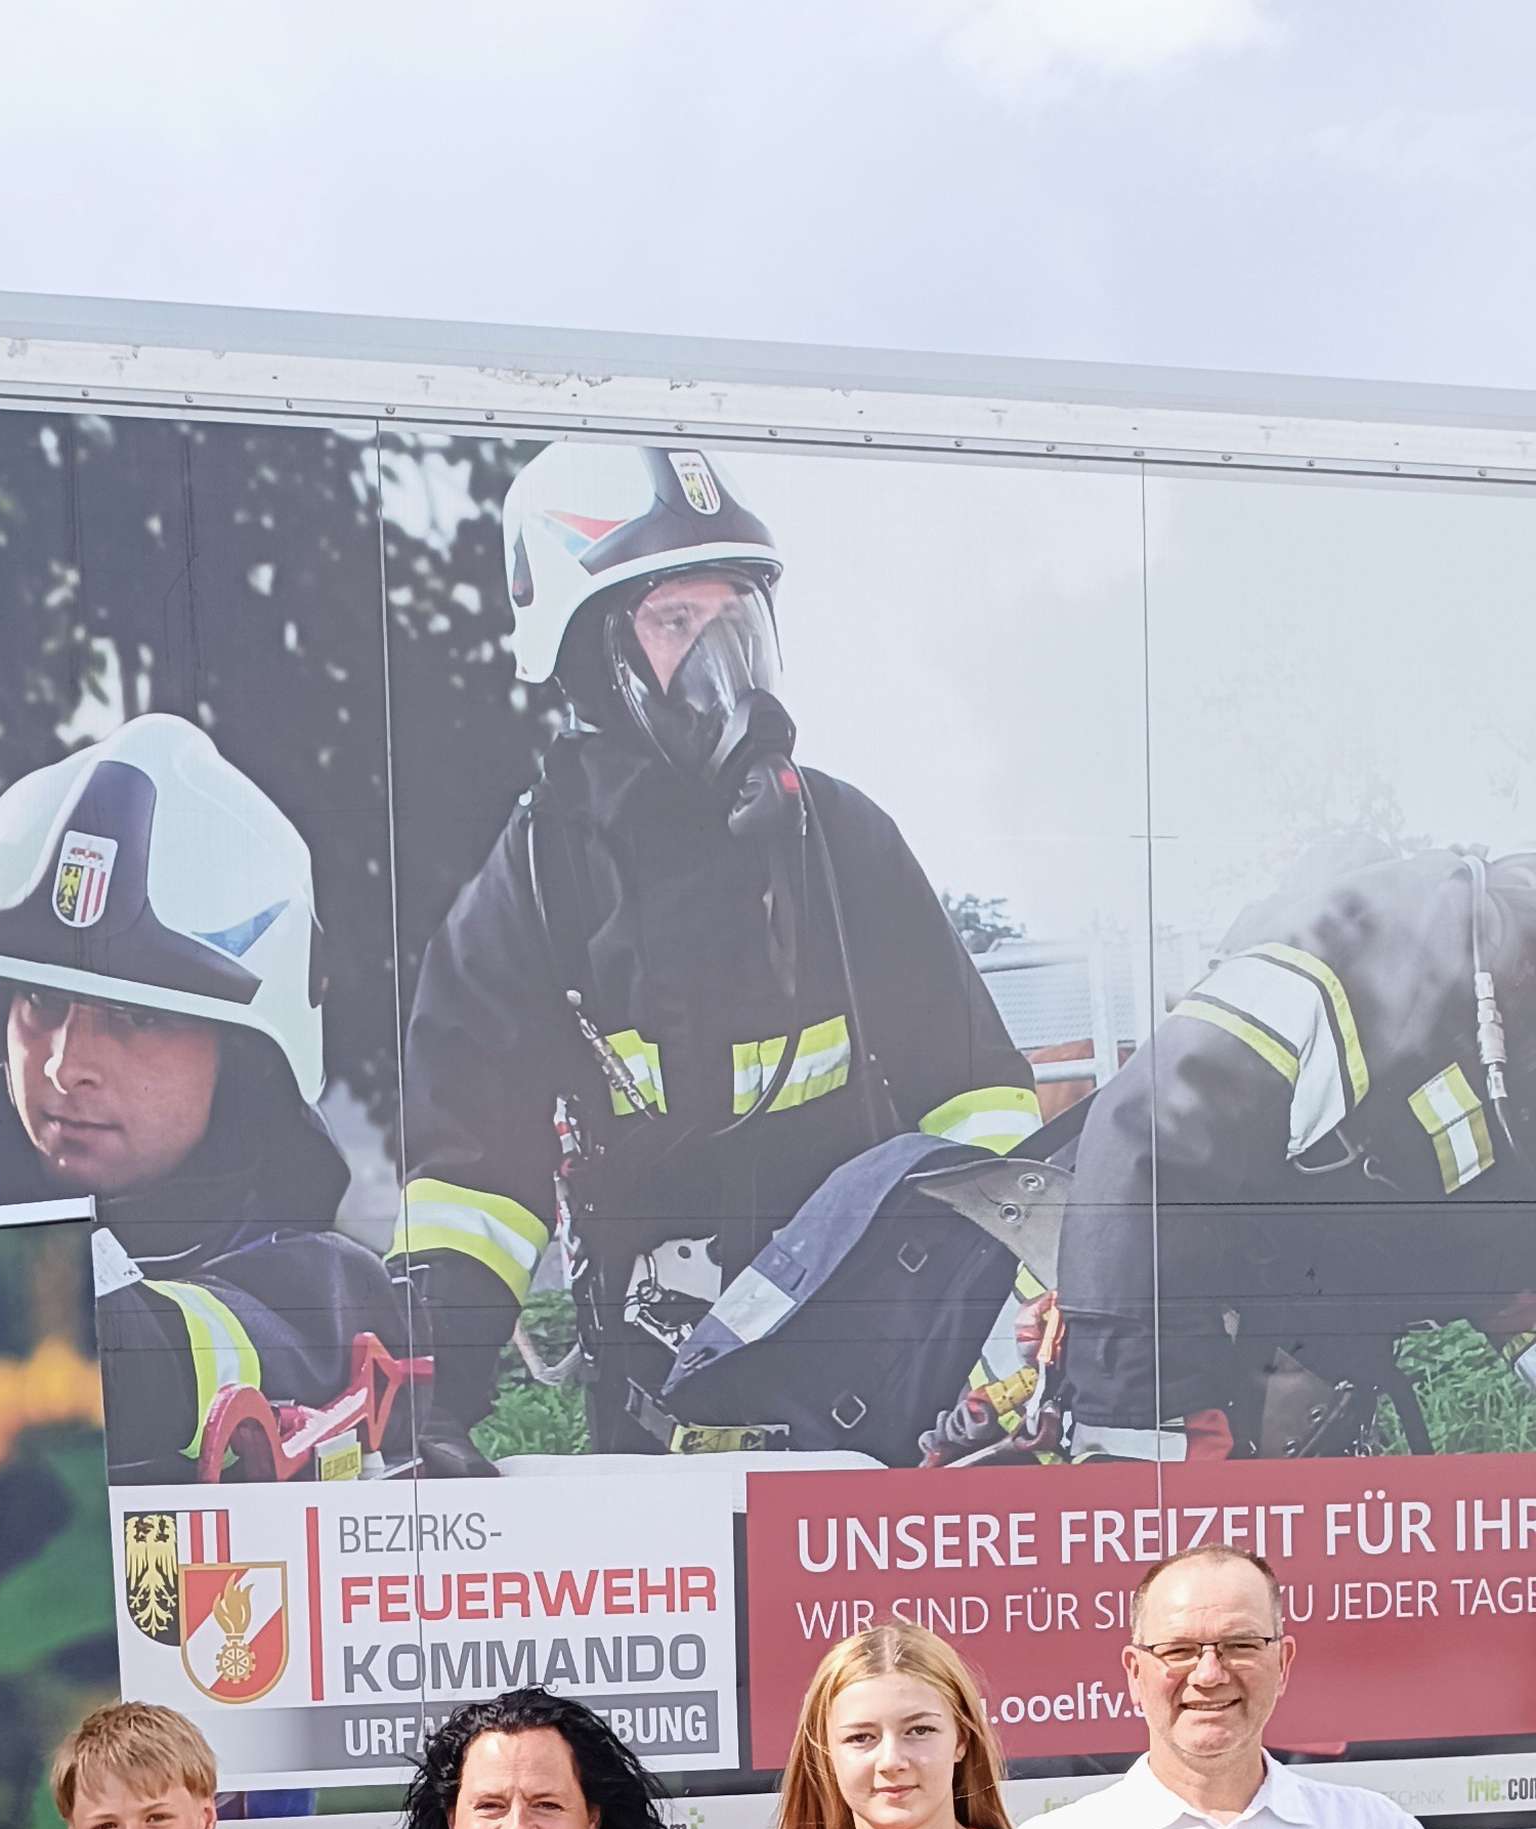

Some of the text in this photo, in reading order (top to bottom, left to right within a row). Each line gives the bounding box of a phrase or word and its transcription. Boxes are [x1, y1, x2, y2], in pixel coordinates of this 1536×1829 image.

[338, 1512, 503, 1554] BEZIRKS-
[797, 1511, 1037, 1573] UNSERE
[1061, 1504, 1305, 1566] FREIZEIT
[1326, 1490, 1437, 1558] FÜR
[341, 1566, 717, 1624] FEUERWEHR
[796, 1599, 874, 1640] WIR
[890, 1595, 989, 1635] SIND
[1005, 1585, 1080, 1632] FÜR
[1326, 1579, 1439, 1623] JEDER
[343, 1632, 707, 1693] KOMMANDO
